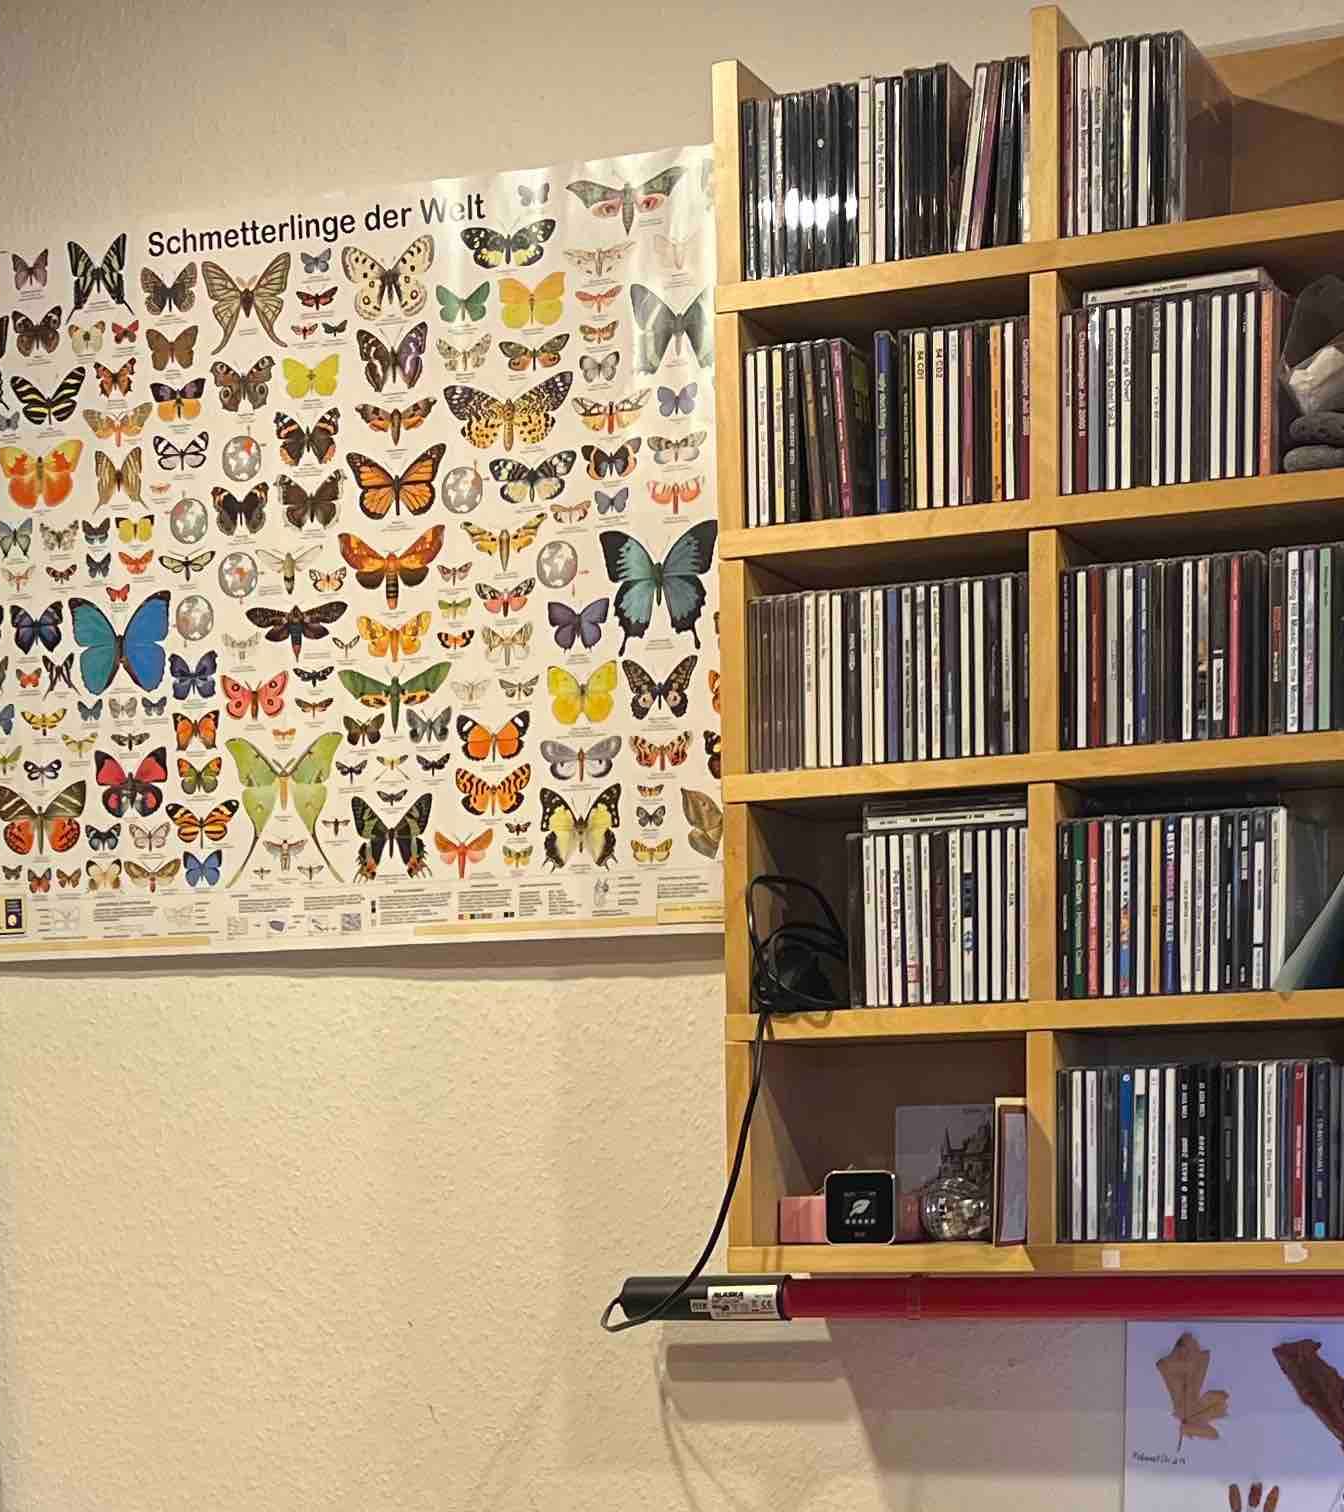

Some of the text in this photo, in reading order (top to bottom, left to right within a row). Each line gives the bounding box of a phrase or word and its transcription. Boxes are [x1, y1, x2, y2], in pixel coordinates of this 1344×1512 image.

[147, 193, 486, 257] Schmetterlinge der Welt
[1122, 326, 1131, 366] Crossing
